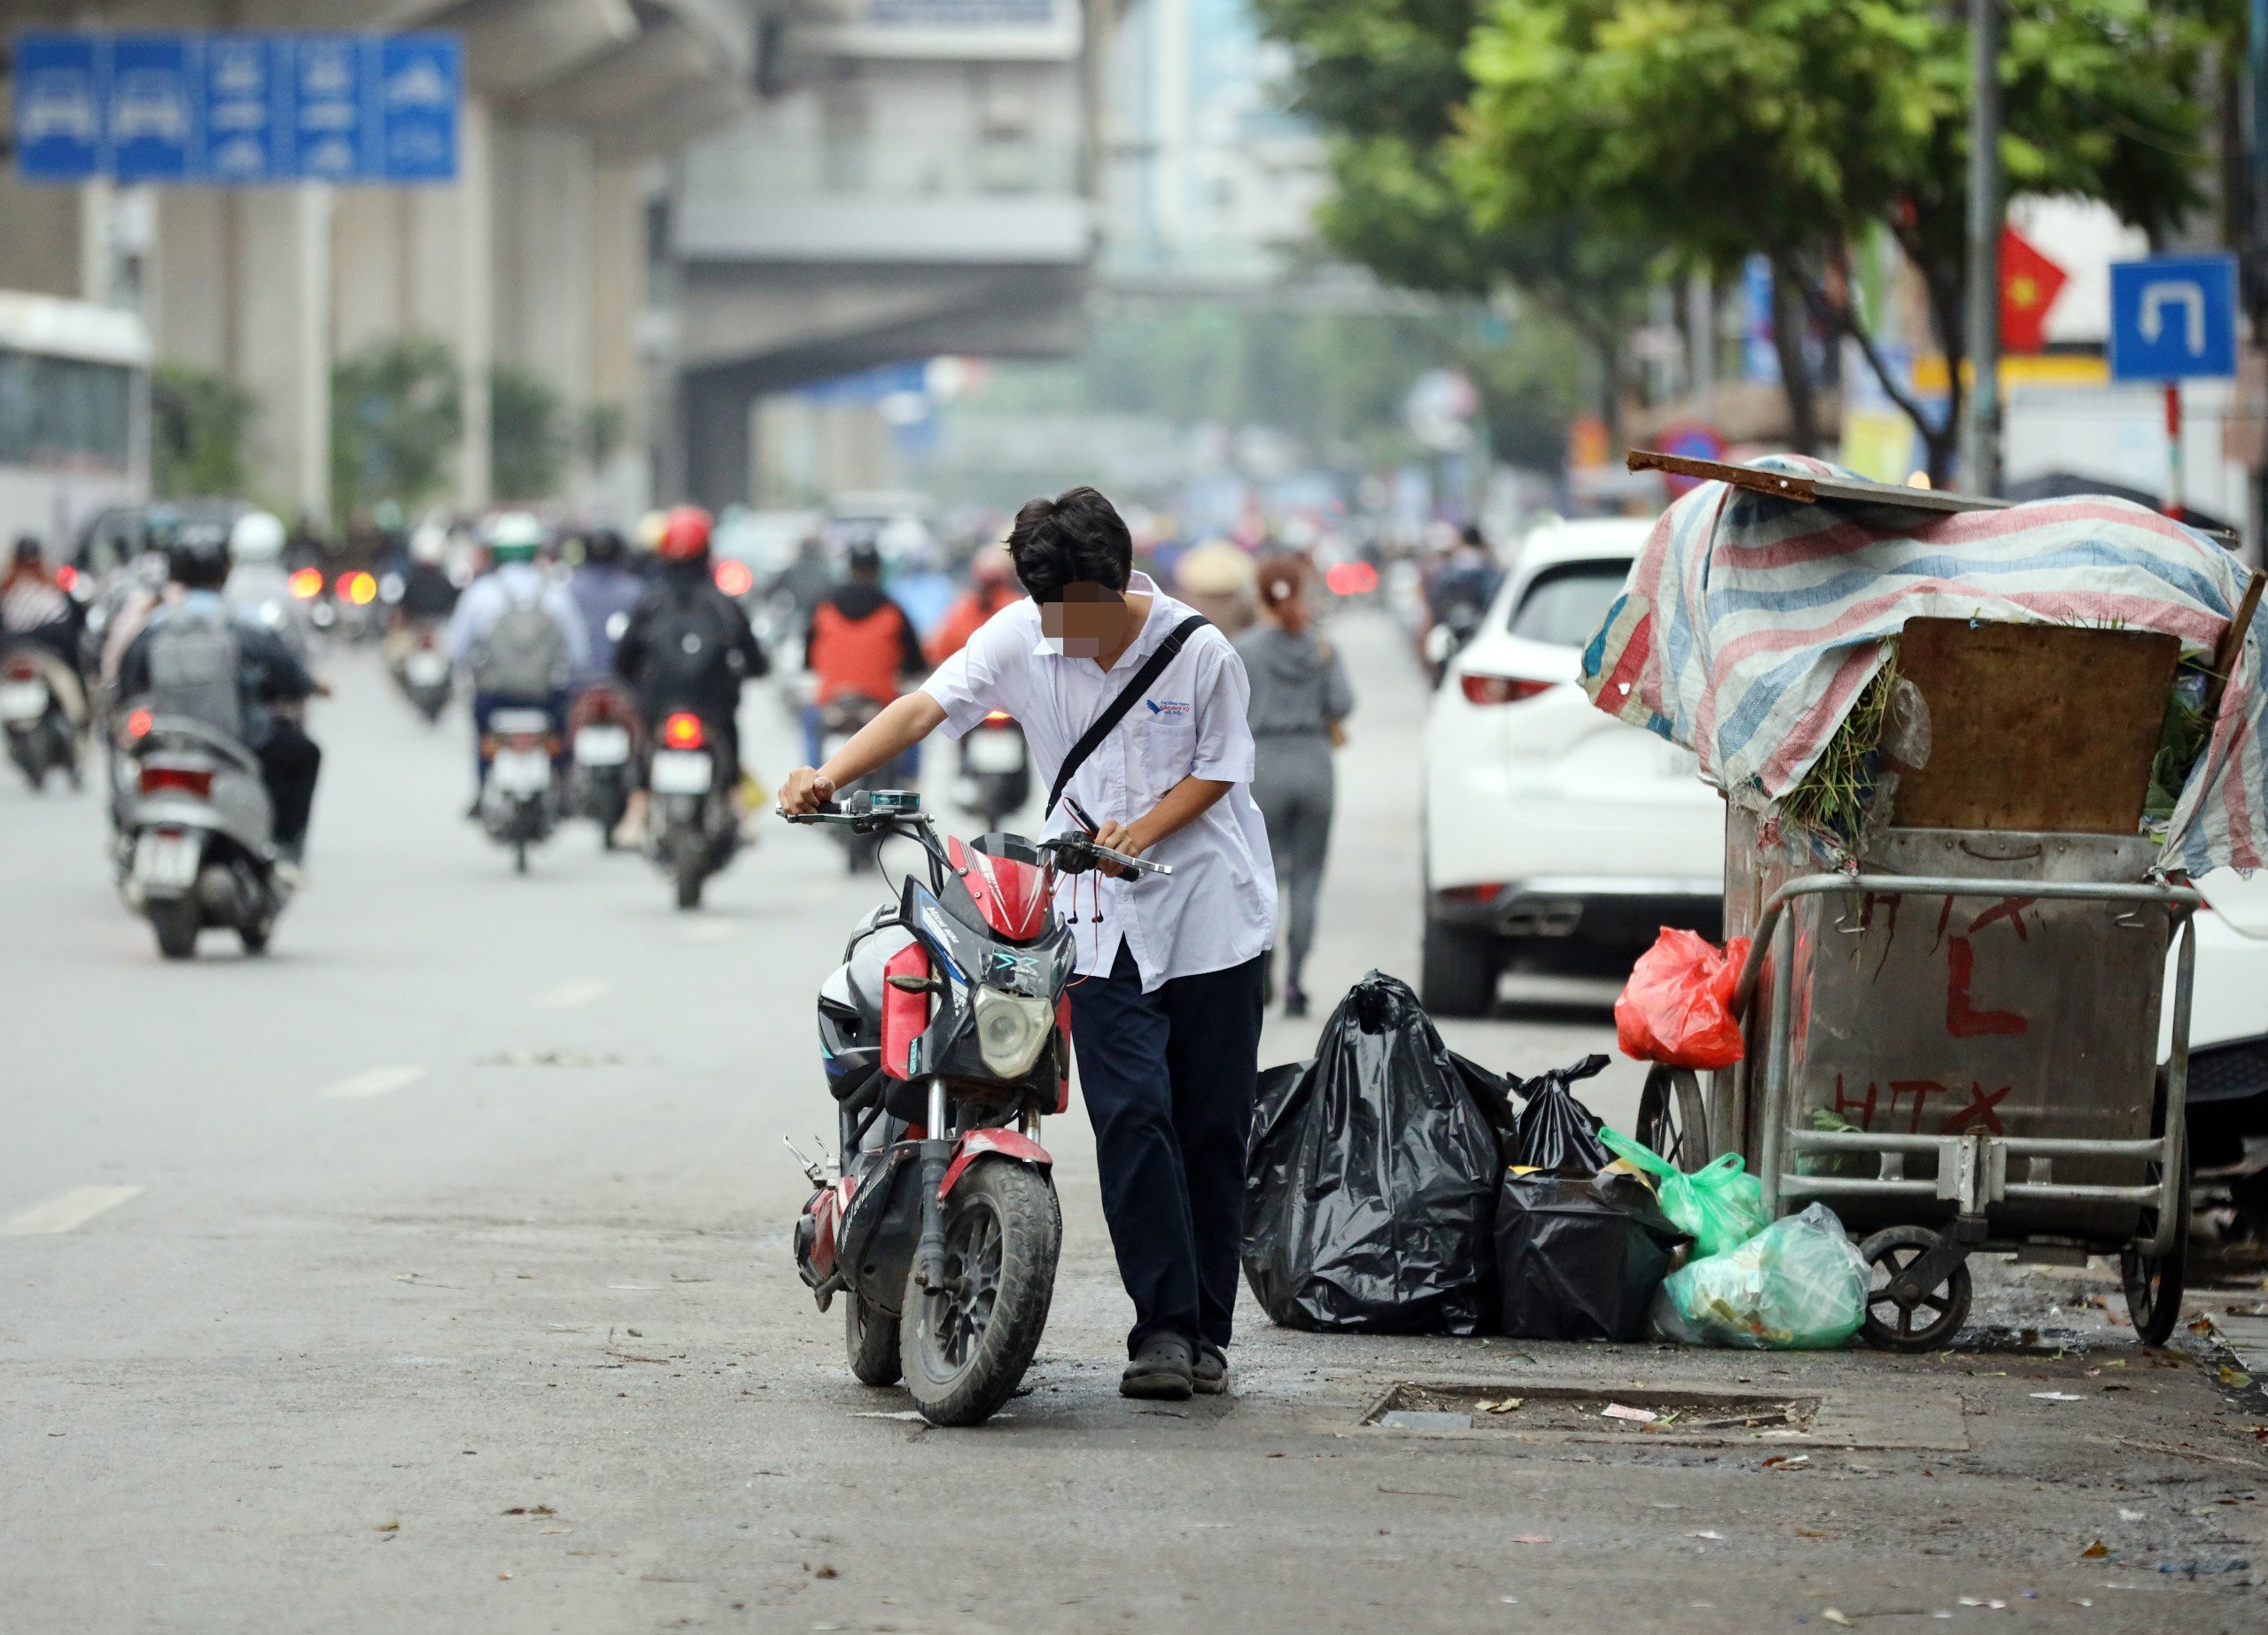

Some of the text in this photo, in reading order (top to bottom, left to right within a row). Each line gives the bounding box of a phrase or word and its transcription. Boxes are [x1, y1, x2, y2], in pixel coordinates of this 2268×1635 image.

[1946, 934, 2028, 1039] L
[909, 1037, 919, 1074] GREEN
[1834, 1073, 2012, 1137] HTX
